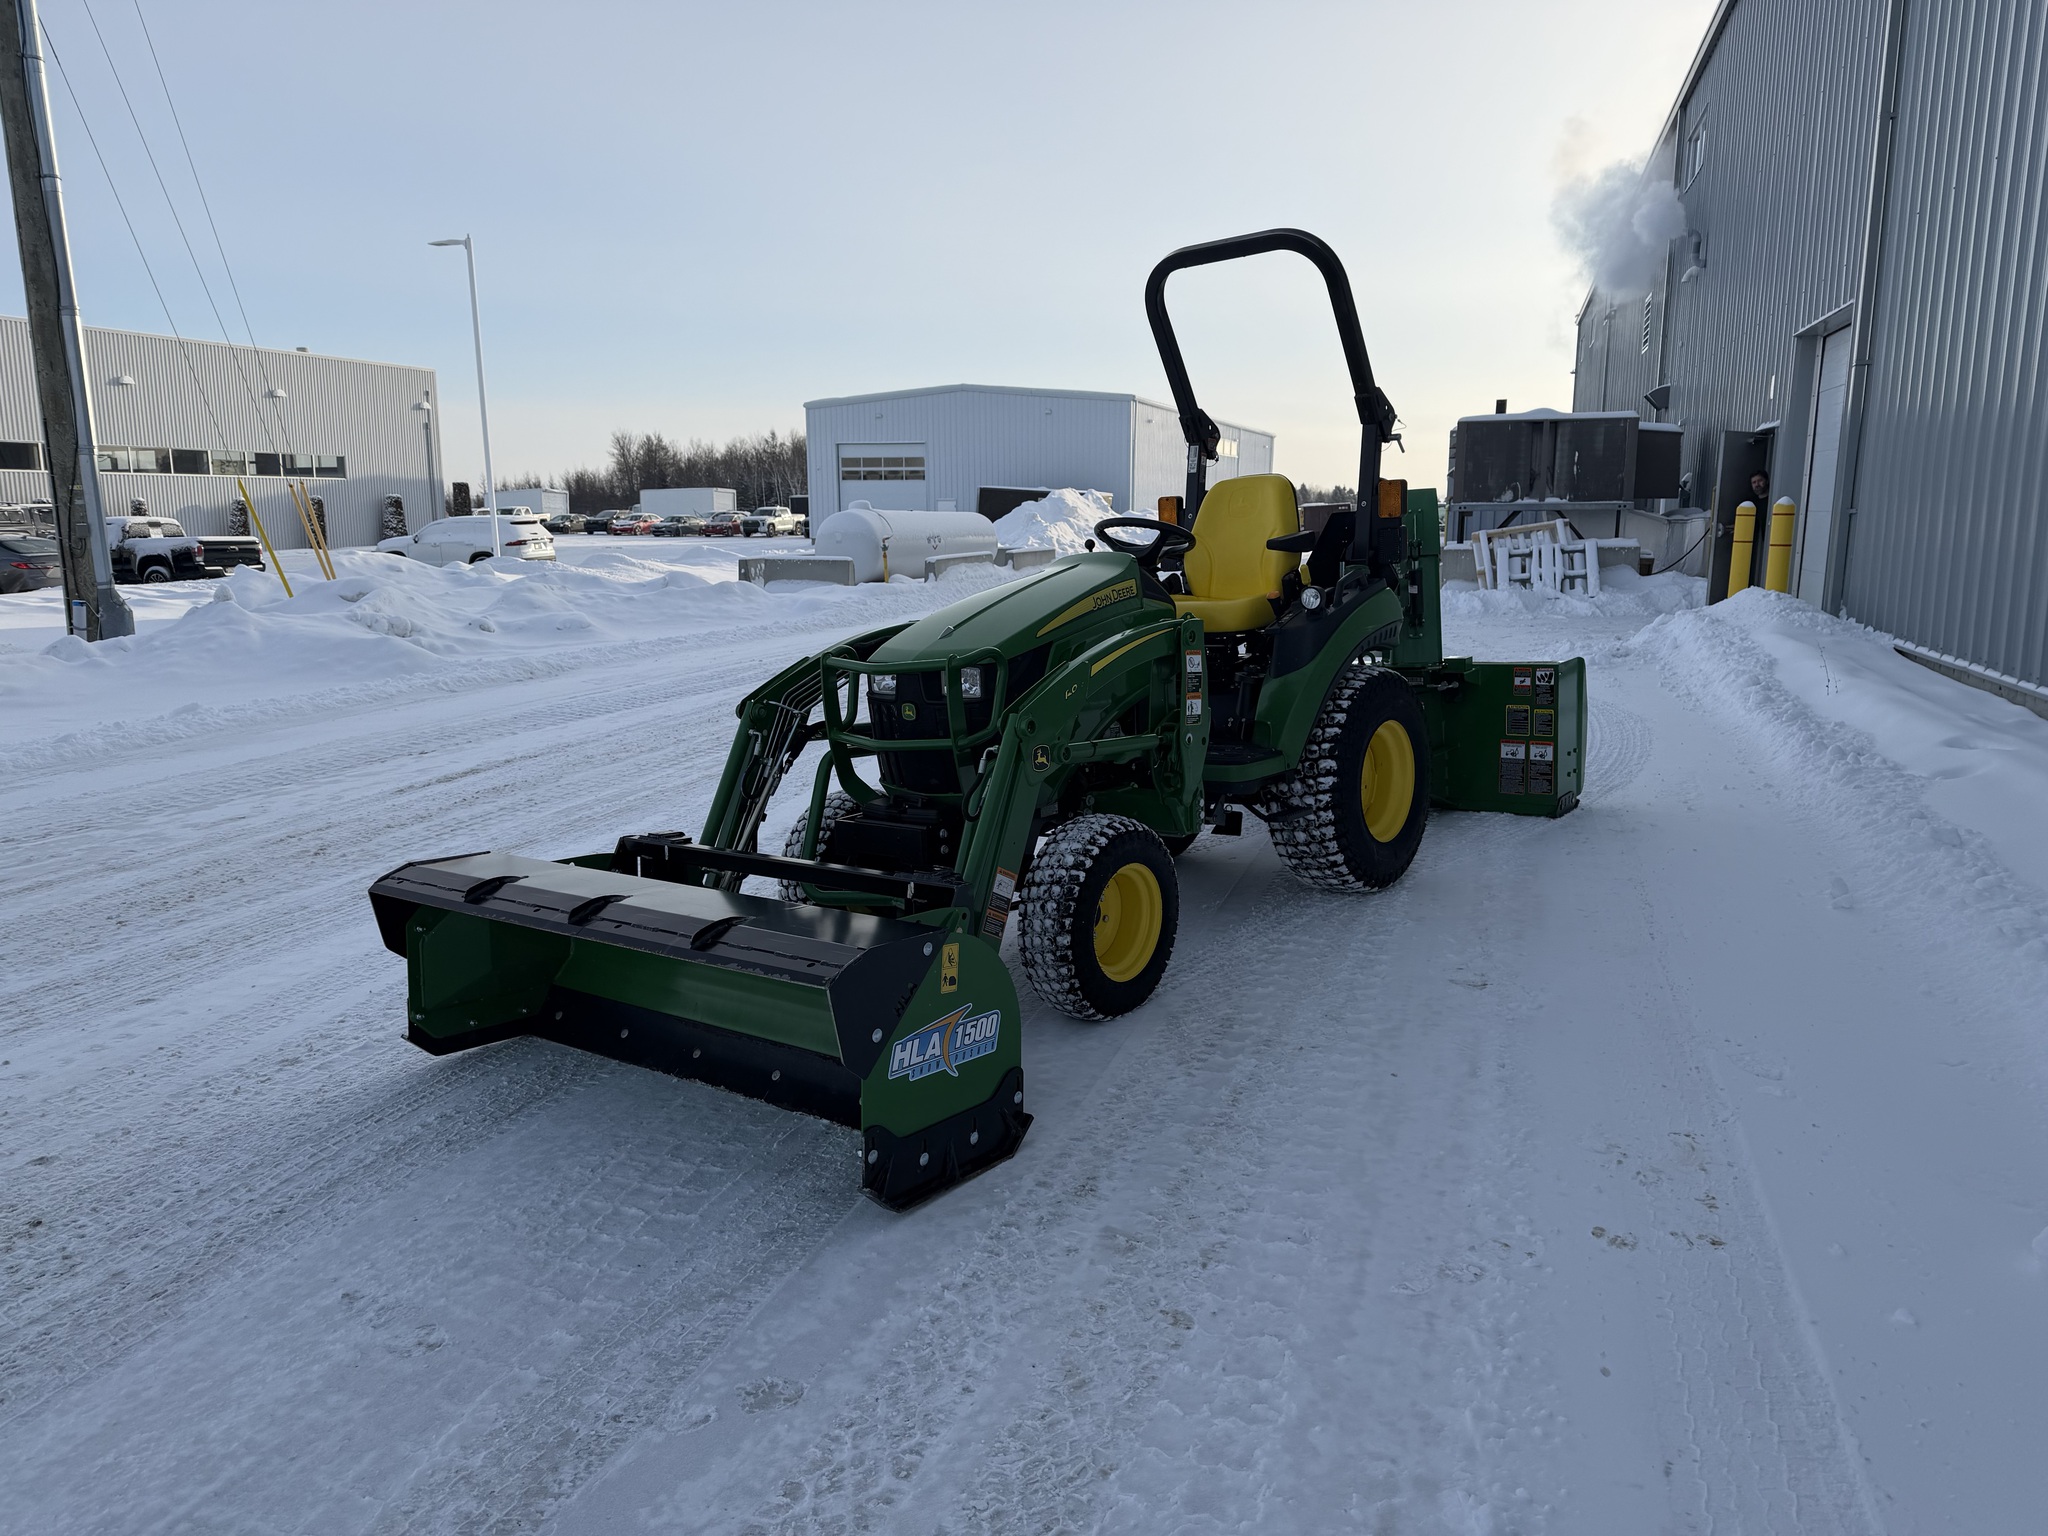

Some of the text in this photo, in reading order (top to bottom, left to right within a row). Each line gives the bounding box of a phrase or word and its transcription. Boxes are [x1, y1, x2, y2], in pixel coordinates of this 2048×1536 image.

[1092, 585, 1136, 609] JOHN DEERE
[891, 1013, 998, 1072] HLA 1500
